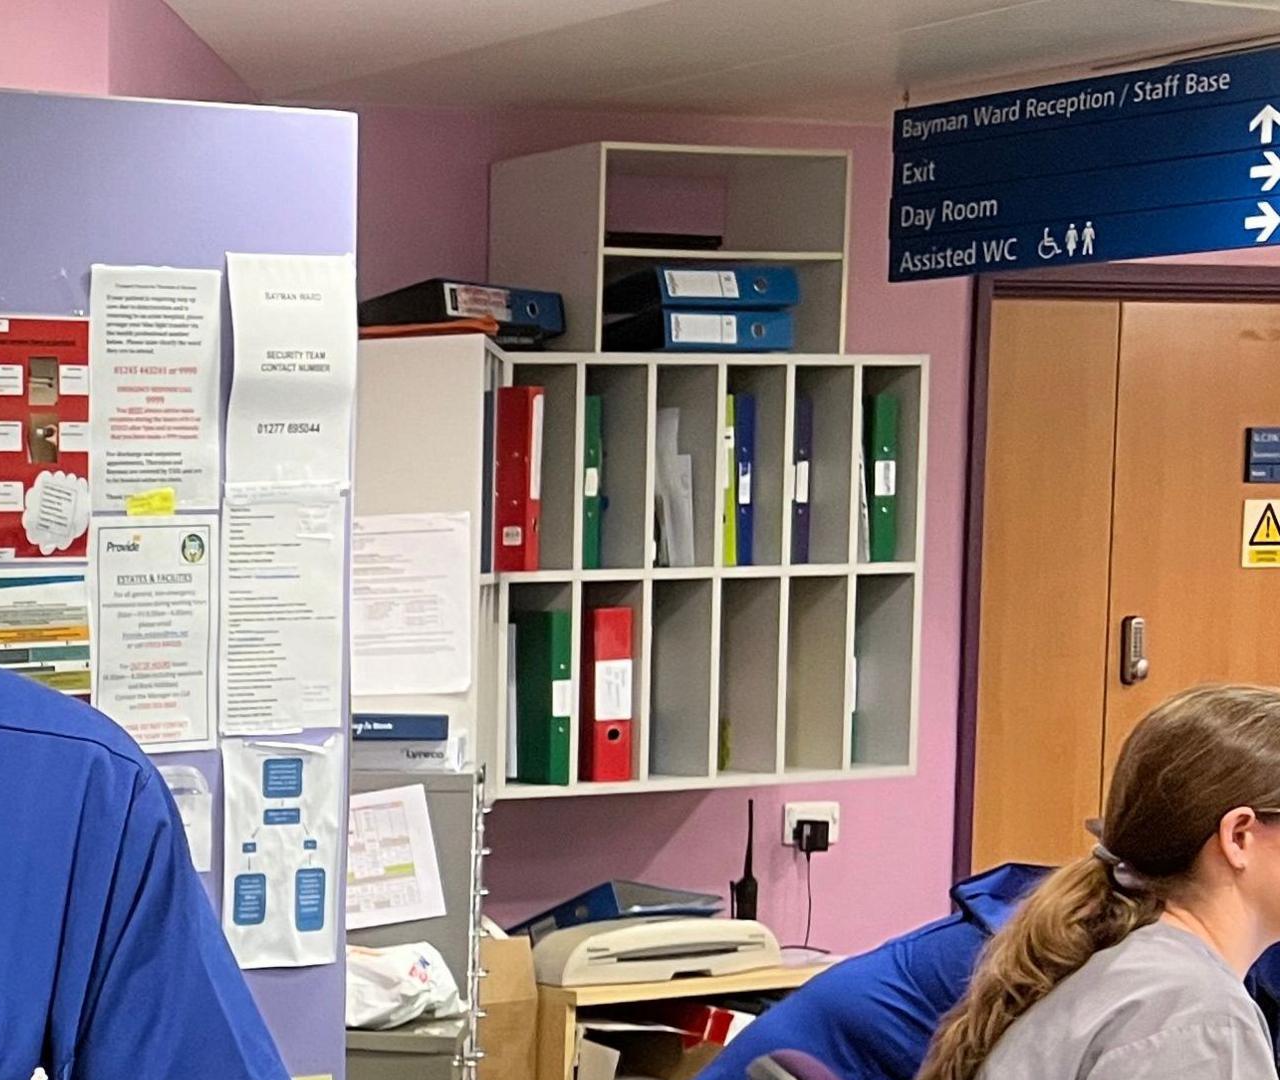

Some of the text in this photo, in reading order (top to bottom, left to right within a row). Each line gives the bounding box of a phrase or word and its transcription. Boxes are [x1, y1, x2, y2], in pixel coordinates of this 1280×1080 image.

[902, 70, 1230, 141] Bayman Ward Reception / Staff Base
[902, 161, 935, 185] Exit
[901, 199, 998, 231] Day Room
[900, 239, 1017, 273] Assisted WC
[266, 351, 326, 360] SECURITY TEAM
[261, 364, 331, 372] CONTACT NUMBER
[257, 424, 284, 434] 01277
[106, 541, 140, 552] Provide
